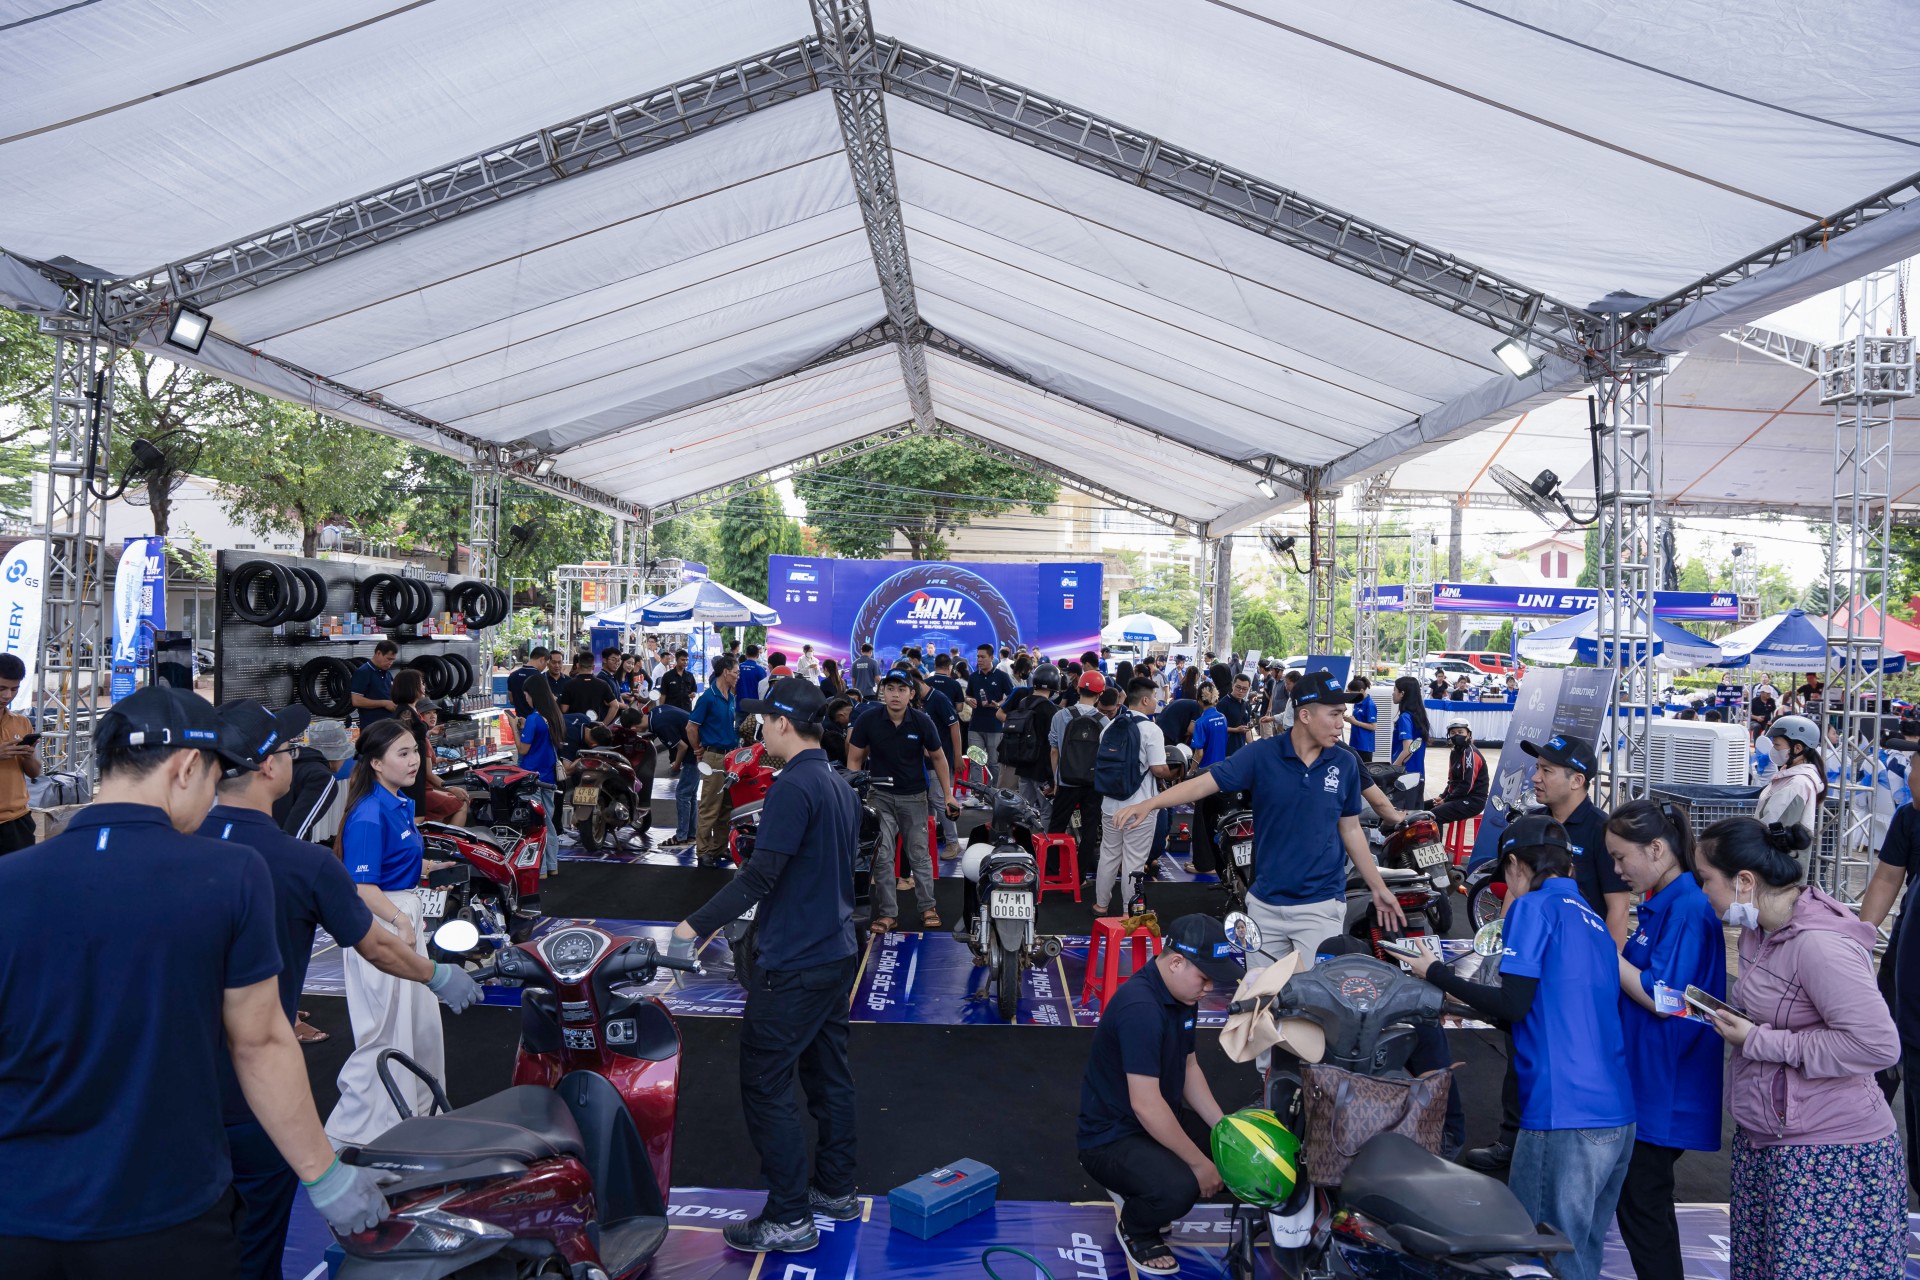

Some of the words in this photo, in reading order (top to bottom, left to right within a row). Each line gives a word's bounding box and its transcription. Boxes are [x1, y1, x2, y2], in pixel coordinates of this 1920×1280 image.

[144, 556, 159, 569] NI
[25, 577, 39, 588] GS
[914, 598, 963, 614] UNI
[1517, 594, 1555, 608] UNI
[1713, 597, 1732, 605] UNI
[907, 611, 938, 619] CARE
[941, 611, 966, 620] DAY
[7, 601, 24, 652] TERY
[1768, 643, 1808, 652] IRC
[1528, 727, 1542, 739] QUY
[1237, 845, 1251, 855] 77-
[1418, 852, 1447, 867] 140.52
[998, 893, 1026, 905] 47-M1
[422, 902, 441, 915] 9.24
[994, 905, 1030, 918] 008.60
[877, 950, 900, 973] CHĂM
[872, 973, 896, 992] SÓC
[867, 992, 895, 1011] LỐP
[669, 1005, 745, 1013] FREE
[1171, 1221, 1240, 1233] RE
